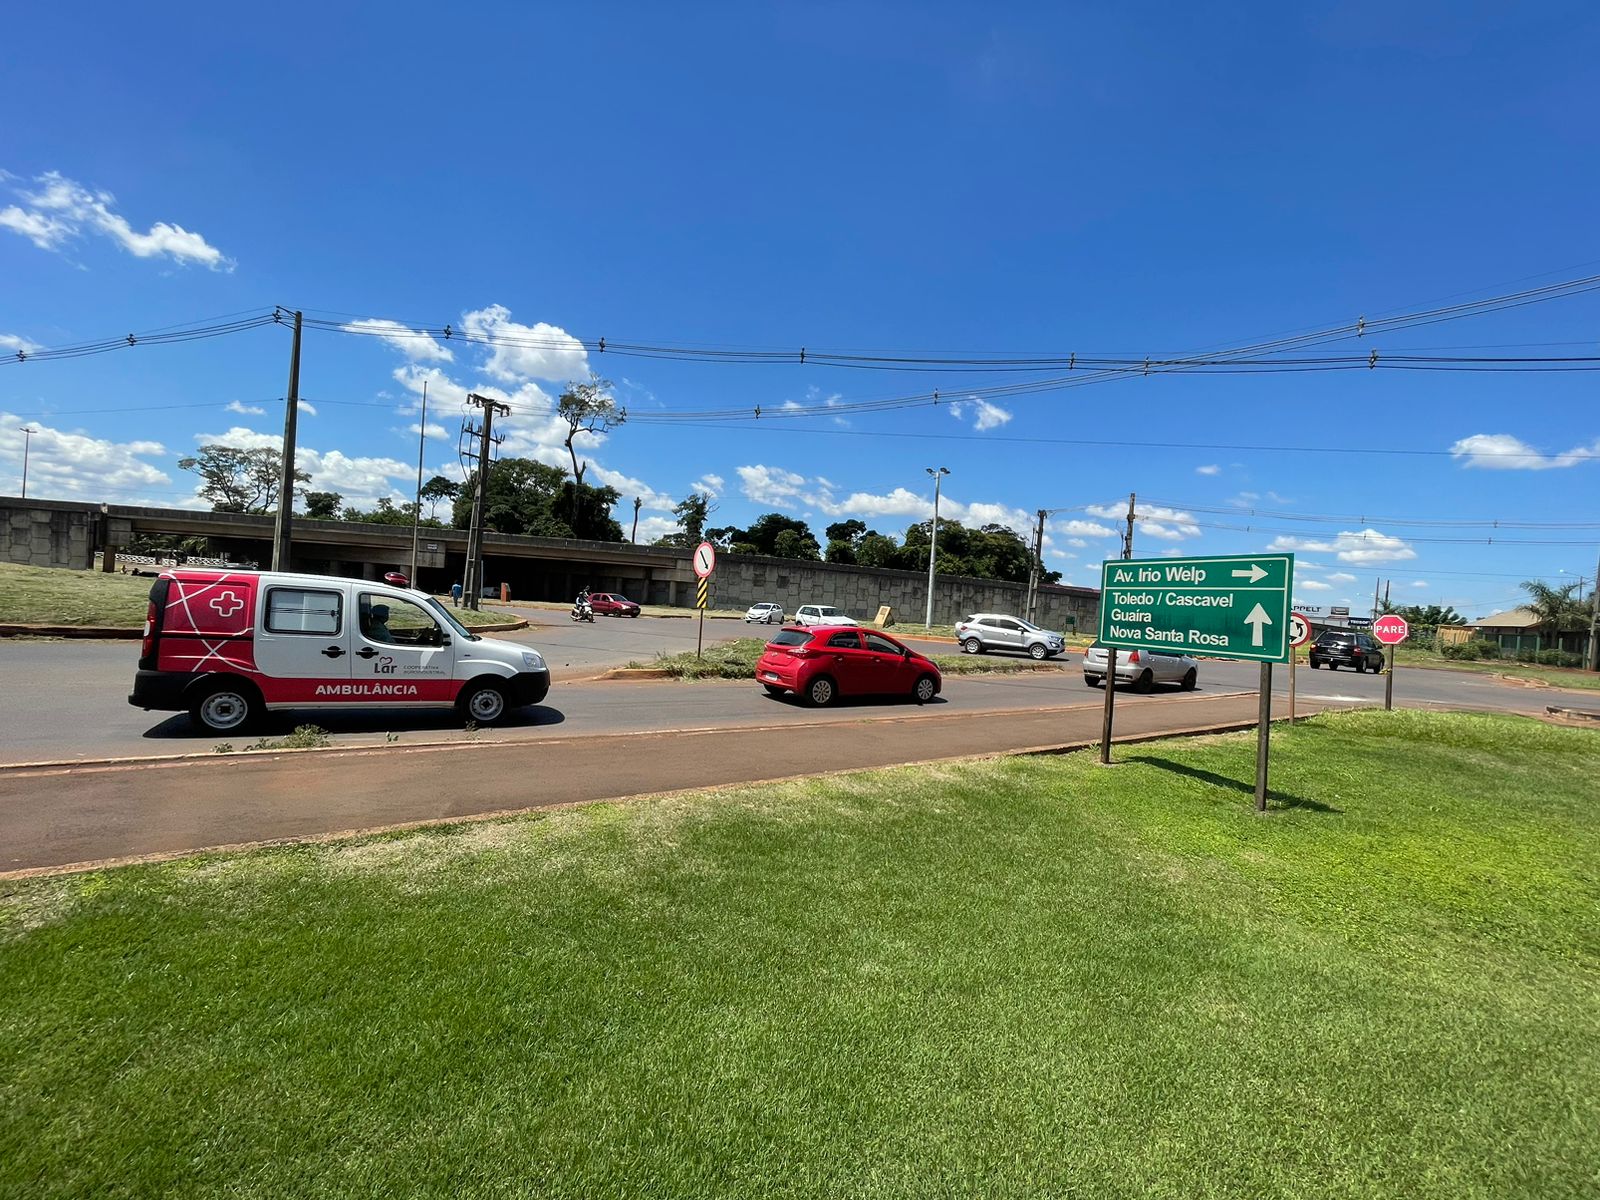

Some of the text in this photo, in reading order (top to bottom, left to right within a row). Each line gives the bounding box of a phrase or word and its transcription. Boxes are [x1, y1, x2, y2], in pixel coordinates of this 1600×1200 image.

[1113, 566, 1206, 585] Av. Irio Welp
[1112, 592, 1234, 608] Toledo / Cascavel
[1111, 608, 1152, 623] Guaíra
[1291, 605, 1321, 613] PPELT
[1109, 625, 1229, 647] Nova Santa Rosa
[1376, 625, 1405, 634] PARE
[374, 662, 398, 674] Lar
[315, 683, 418, 695] AMBULÂNCIA
